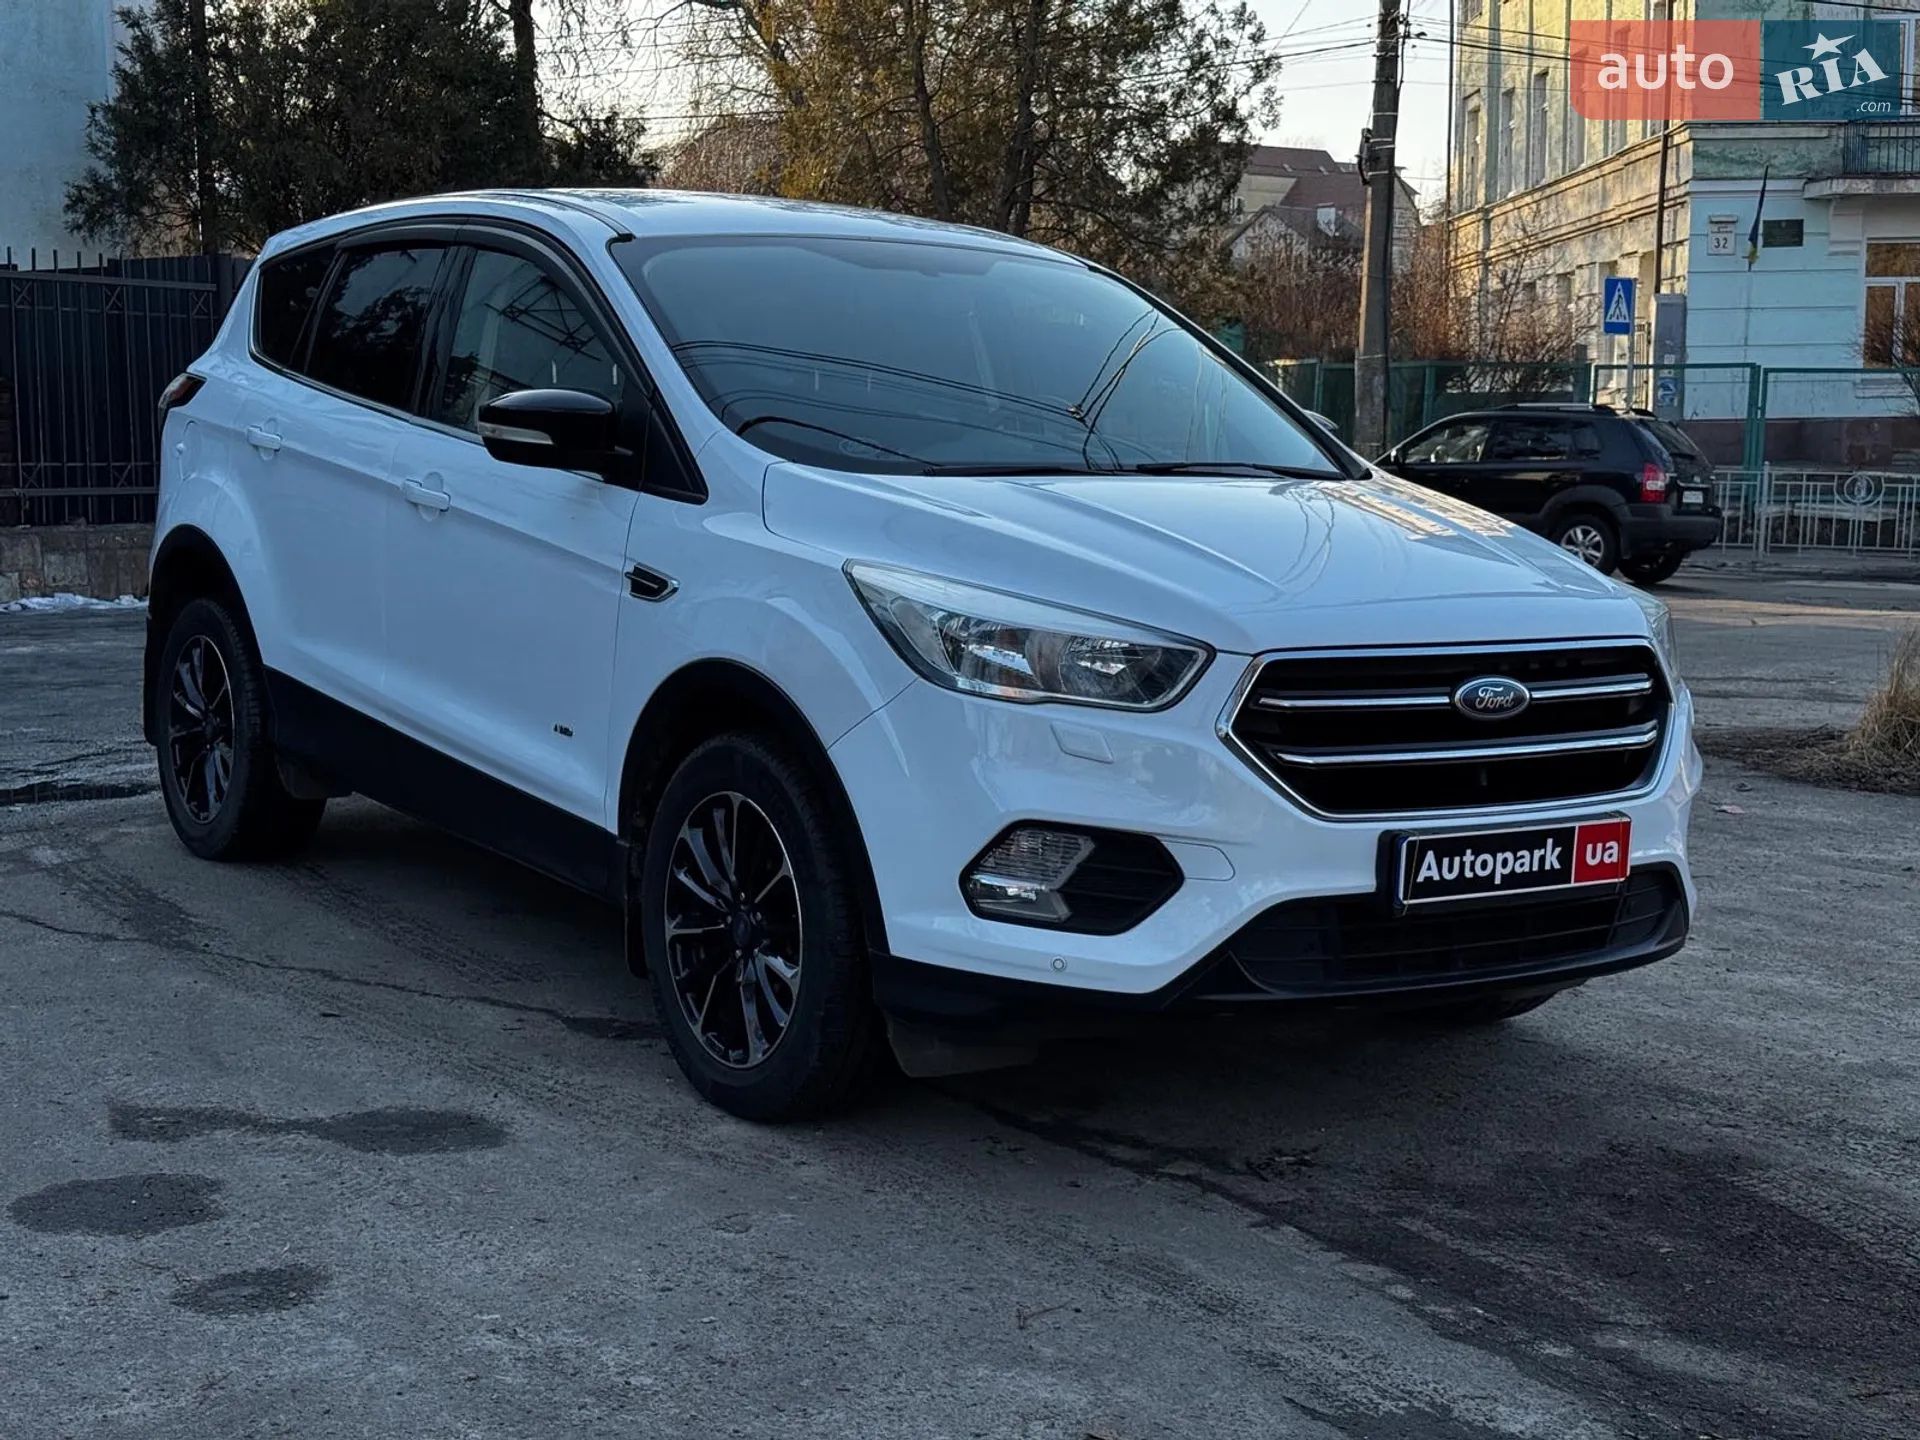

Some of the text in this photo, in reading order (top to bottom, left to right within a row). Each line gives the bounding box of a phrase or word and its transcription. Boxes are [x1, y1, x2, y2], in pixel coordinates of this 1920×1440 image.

[1713, 237, 1729, 250] 32
[1475, 686, 1515, 709] Ford
[1416, 838, 1619, 885] Autopark ua
